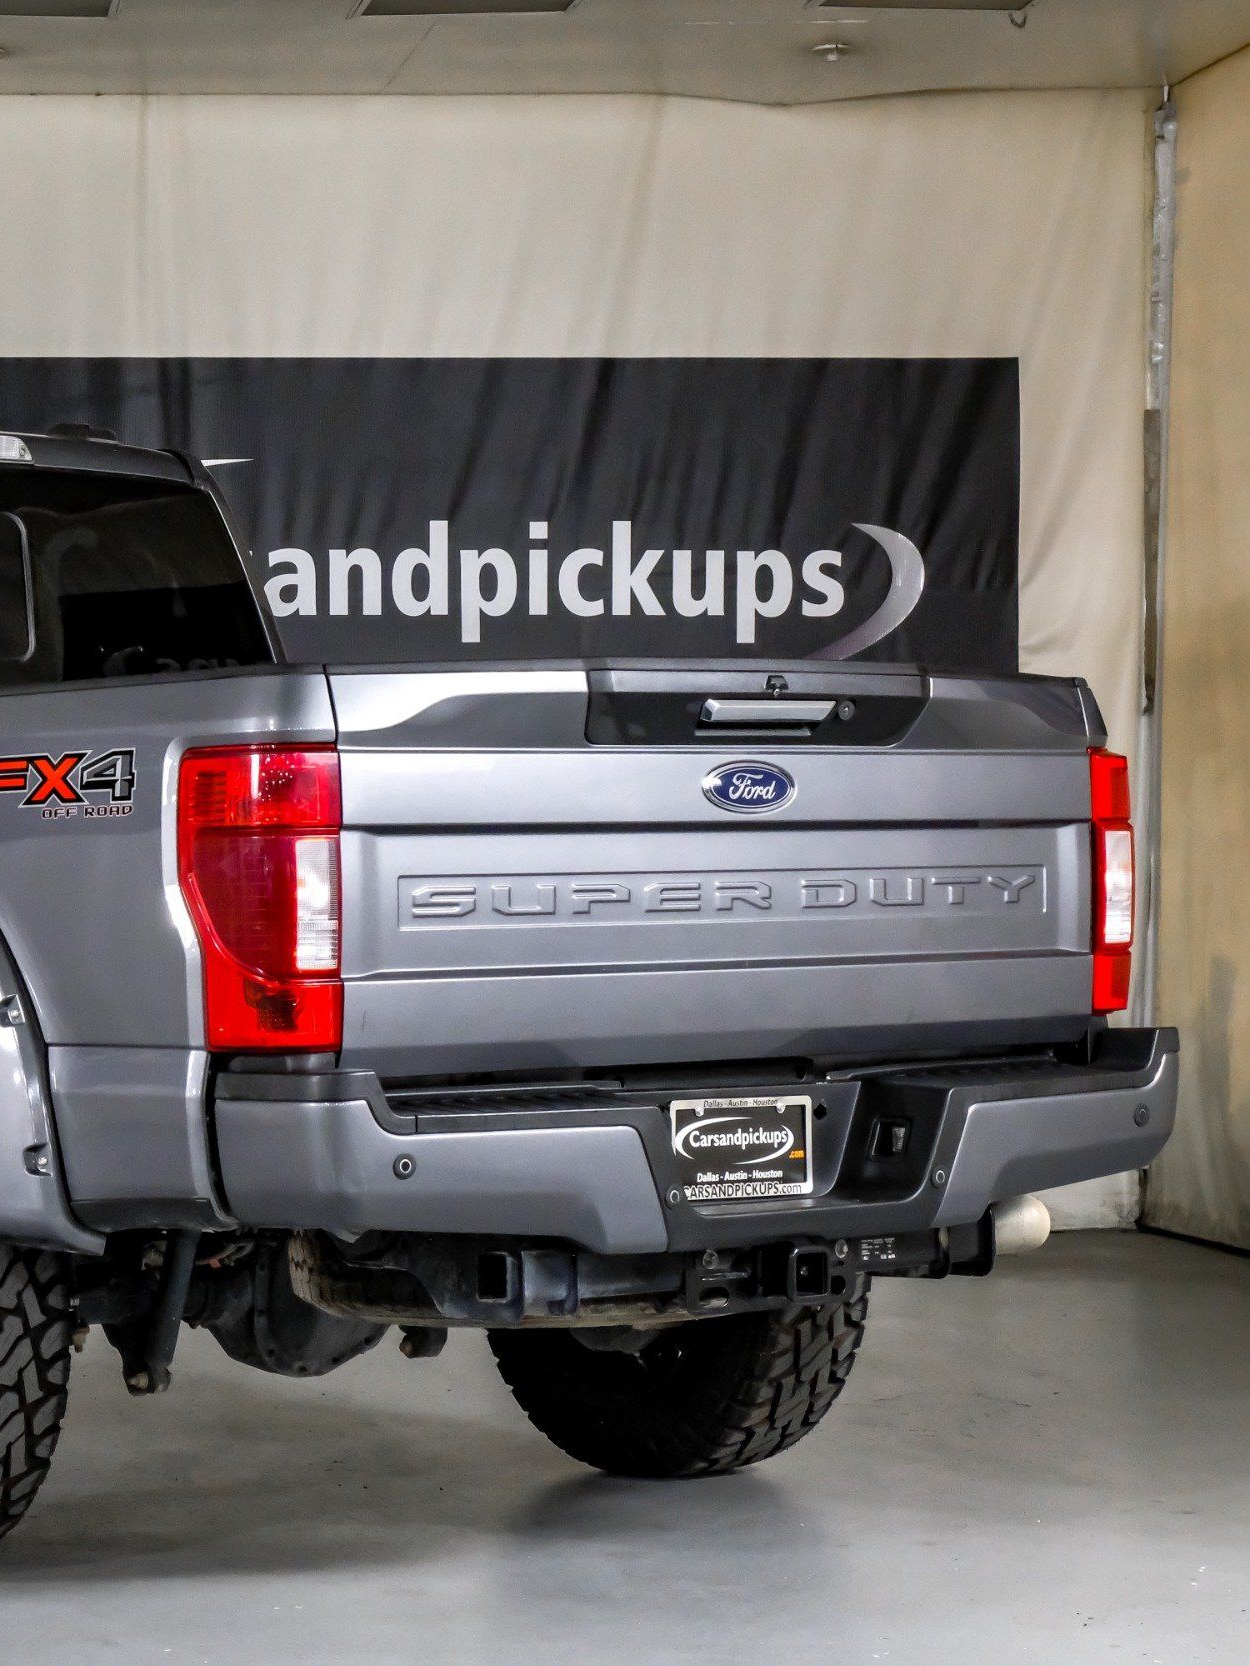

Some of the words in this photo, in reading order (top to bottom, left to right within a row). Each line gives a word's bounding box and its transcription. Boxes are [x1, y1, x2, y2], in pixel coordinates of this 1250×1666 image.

[260, 519, 845, 644] andpickups
[728, 772, 776, 800] Ford
[42, 807, 77, 819] OFF
[84, 804, 134, 818] ROAD
[411, 880, 772, 918] SUPER
[800, 874, 1036, 909] DUTY
[703, 1100, 723, 1108] Dallas
[728, 1099, 748, 1107] Austin
[689, 1127, 788, 1150] Carsandpickups
[697, 1172, 720, 1182] Dallas
[724, 1170, 748, 1181] Austin
[752, 1169, 783, 1179] Houston
